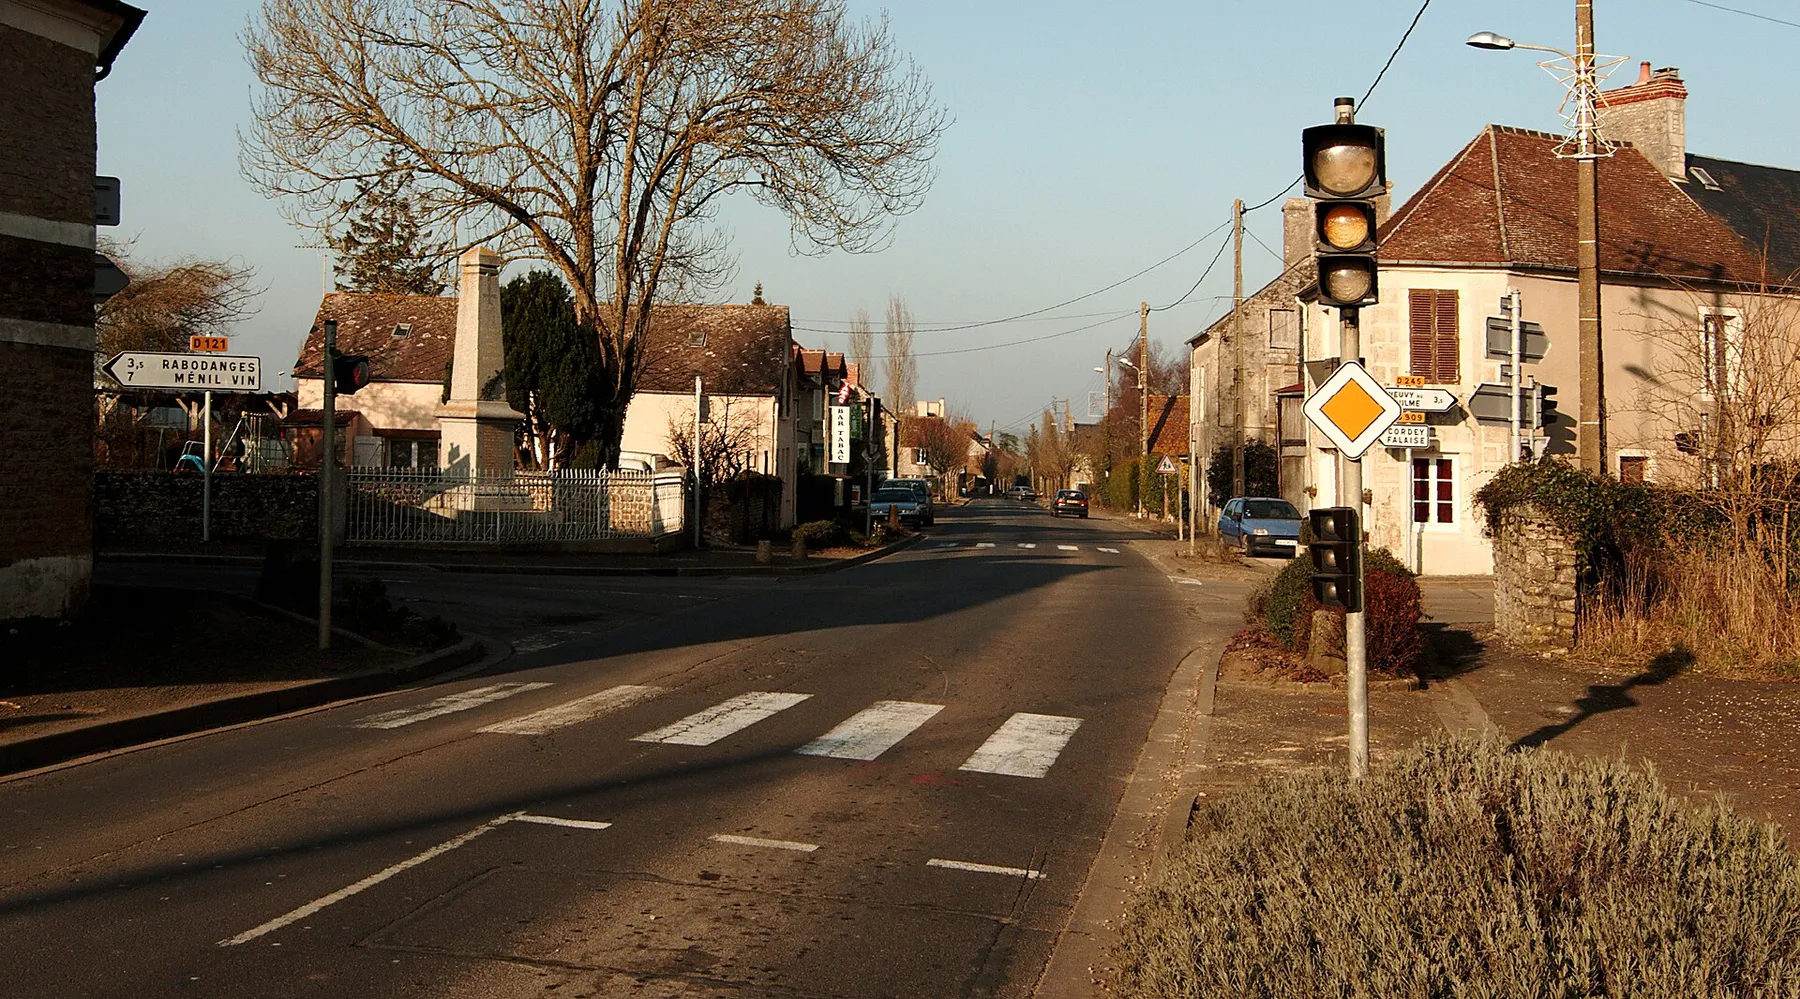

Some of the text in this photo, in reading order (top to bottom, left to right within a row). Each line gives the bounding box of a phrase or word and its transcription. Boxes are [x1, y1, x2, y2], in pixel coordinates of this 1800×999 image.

[193, 338, 226, 349] D 121
[127, 358, 255, 373] 3,5 RABODANGES
[127, 370, 255, 386] 7 MÉNIL VIN
[1388, 428, 1425, 436] CORDEY
[1387, 436, 1425, 444] FALAISE
